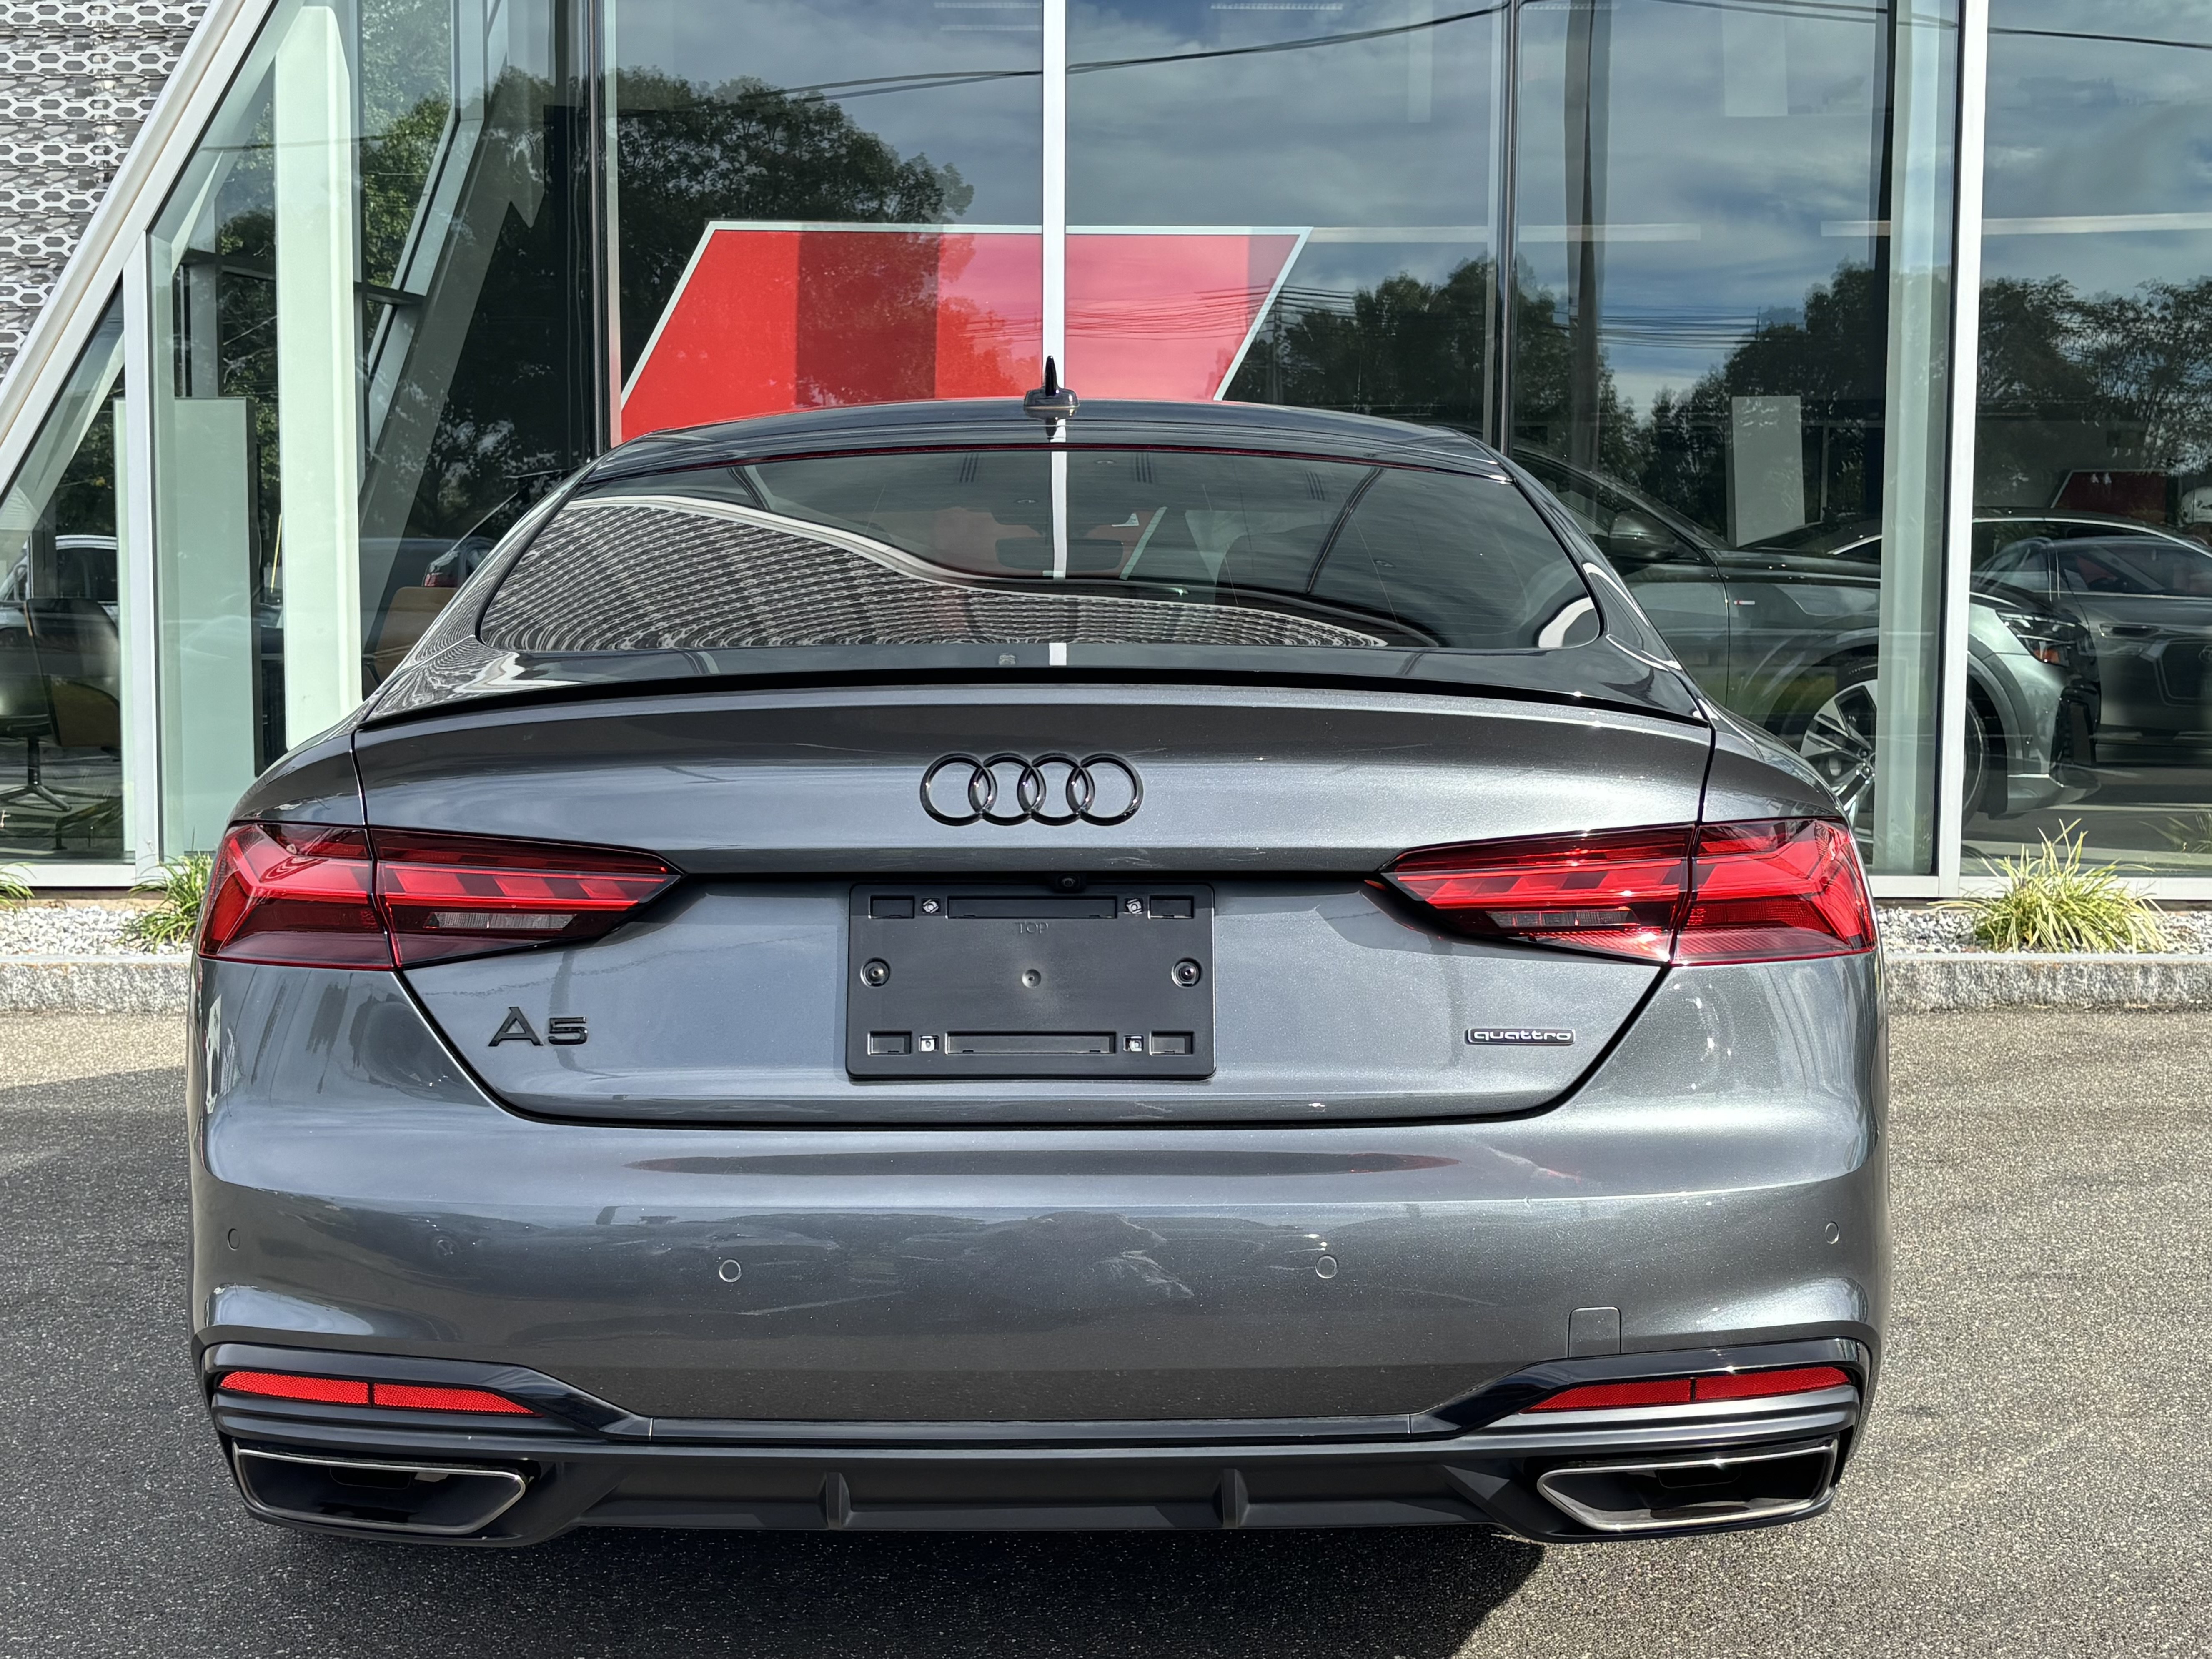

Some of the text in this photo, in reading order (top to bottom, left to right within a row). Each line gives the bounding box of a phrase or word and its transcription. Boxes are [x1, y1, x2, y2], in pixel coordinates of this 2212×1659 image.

[1015, 921, 1049, 934] TOP
[488, 1006, 589, 1047] A5
[1474, 1030, 1571, 1041] quattro
